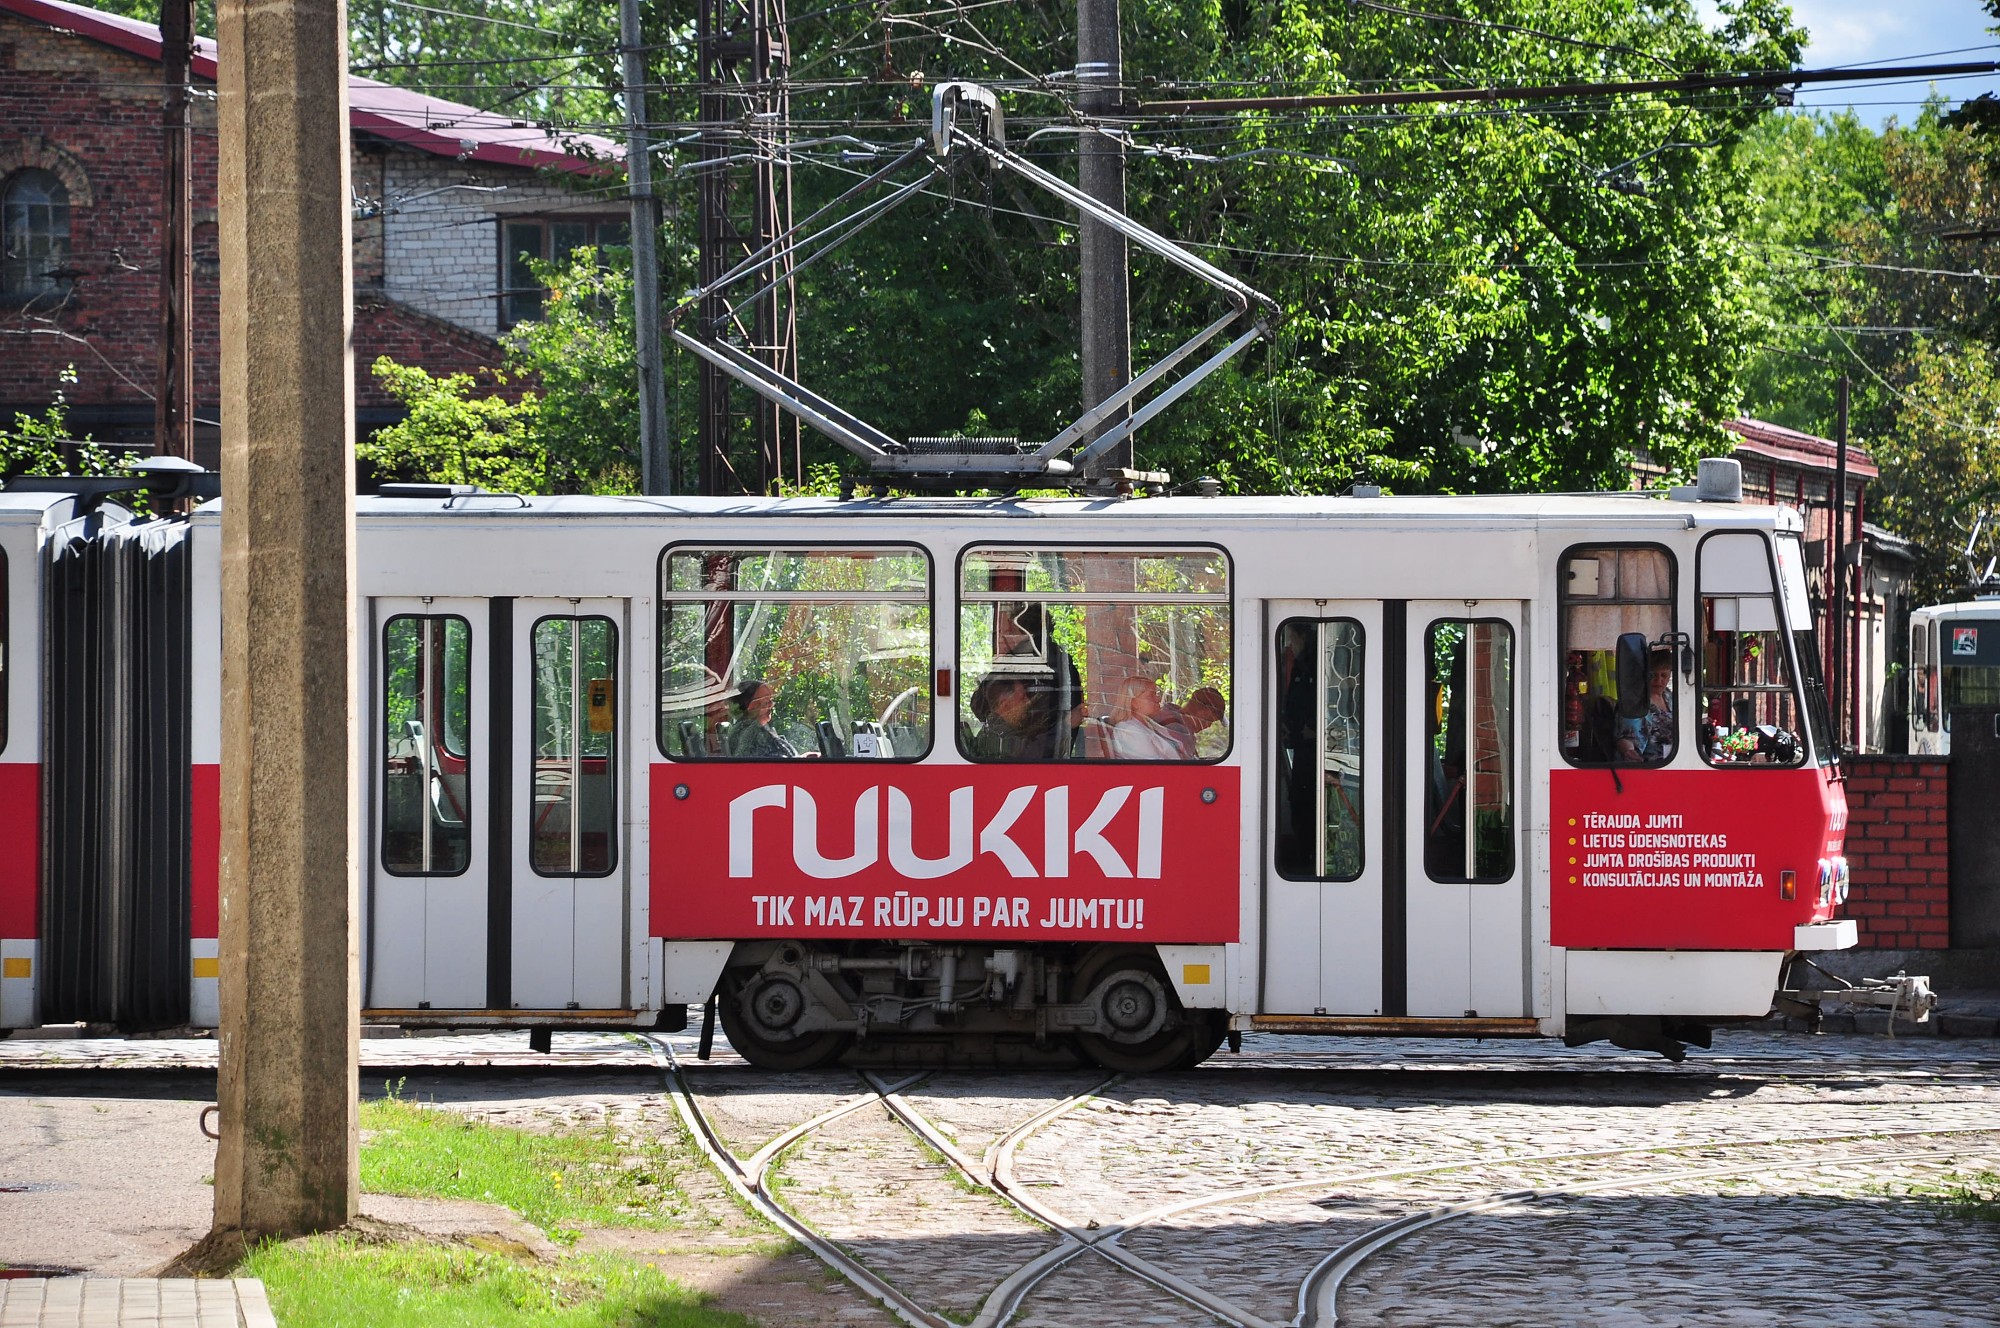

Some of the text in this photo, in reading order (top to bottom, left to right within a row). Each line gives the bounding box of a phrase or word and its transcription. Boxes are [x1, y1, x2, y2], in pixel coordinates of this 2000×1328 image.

[1583, 811, 1683, 829] TĒRAUDA JUMTI
[1583, 830, 1727, 849] LIETUS ŪDENSNOTEKAS
[1583, 850, 1756, 868] JUMTA DROŠĪBAS PRODUKTI
[1583, 870, 1764, 888] KONSULTĀCIJAS UN MONTĀŽA
[751, 890, 1144, 930] TIK MAZ RŪPJU PAR JUMTU!
